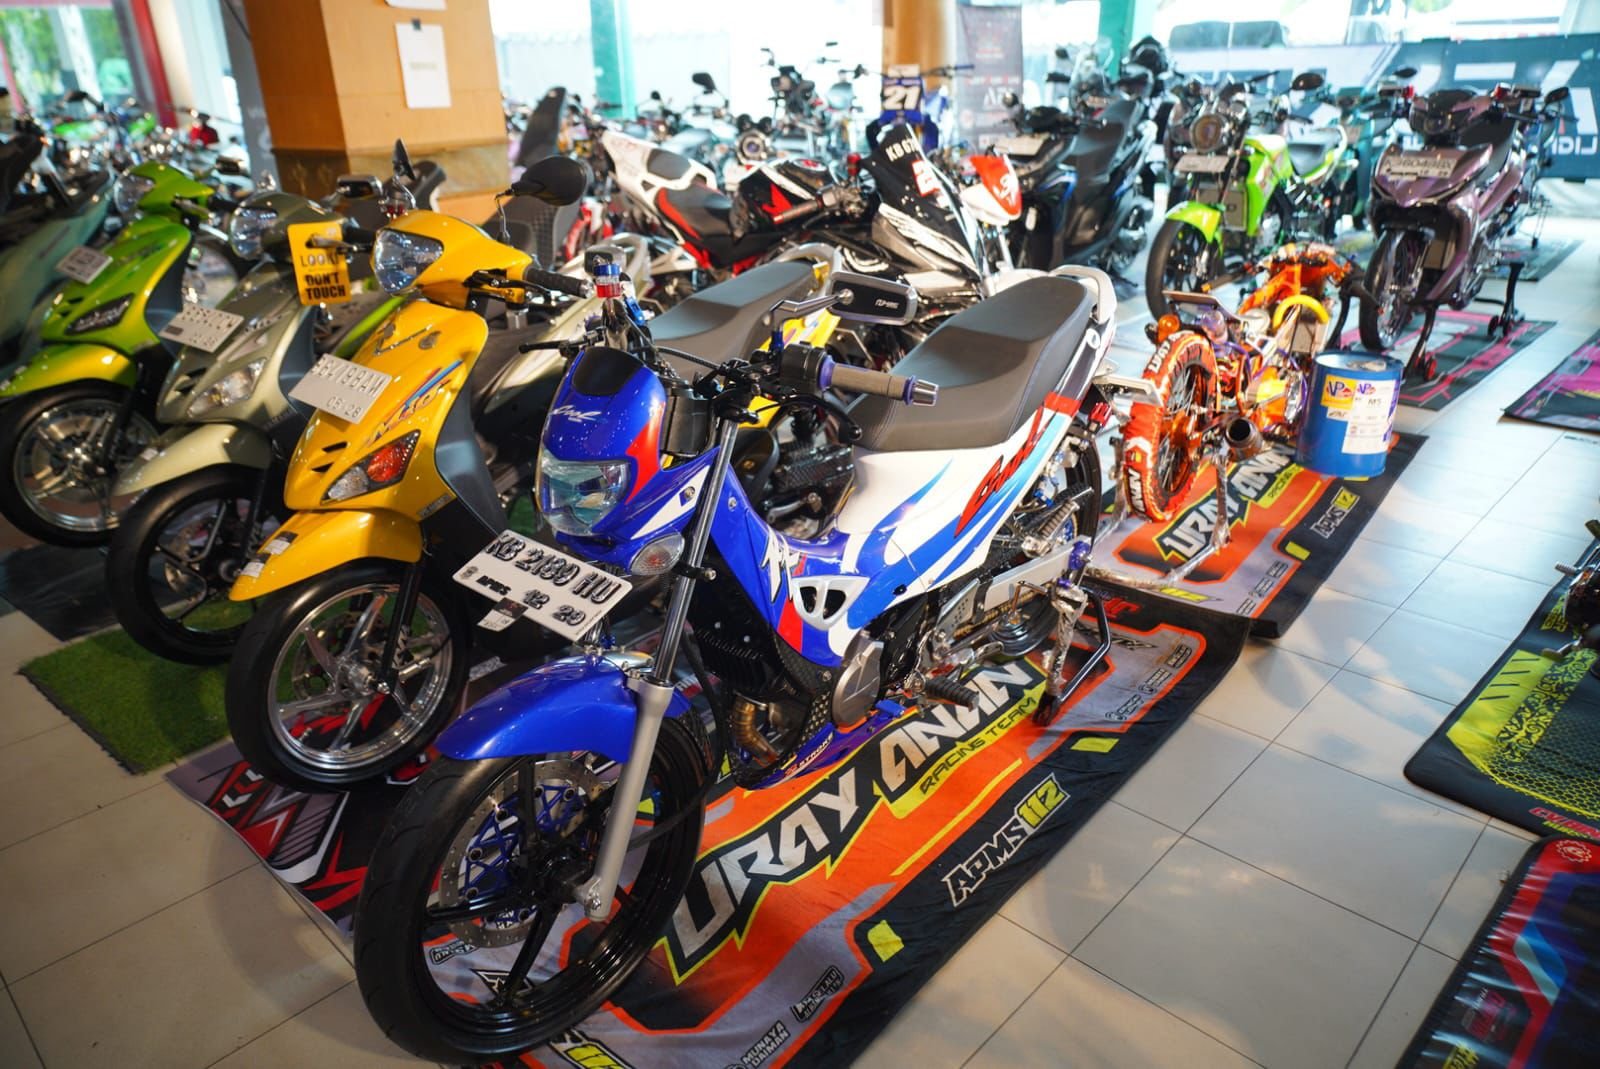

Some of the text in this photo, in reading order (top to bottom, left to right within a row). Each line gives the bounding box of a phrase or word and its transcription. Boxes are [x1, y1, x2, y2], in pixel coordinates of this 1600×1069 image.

[882, 86, 921, 110] 21
[305, 272, 339, 286] DON'T
[305, 285, 346, 300] TOUCH
[920, 696, 1037, 795] RACING TEAM
[672, 767, 859, 959] URAY
[742, 1021, 785, 1065] MUNAYA
[751, 1030, 790, 1067] DAIMAN
